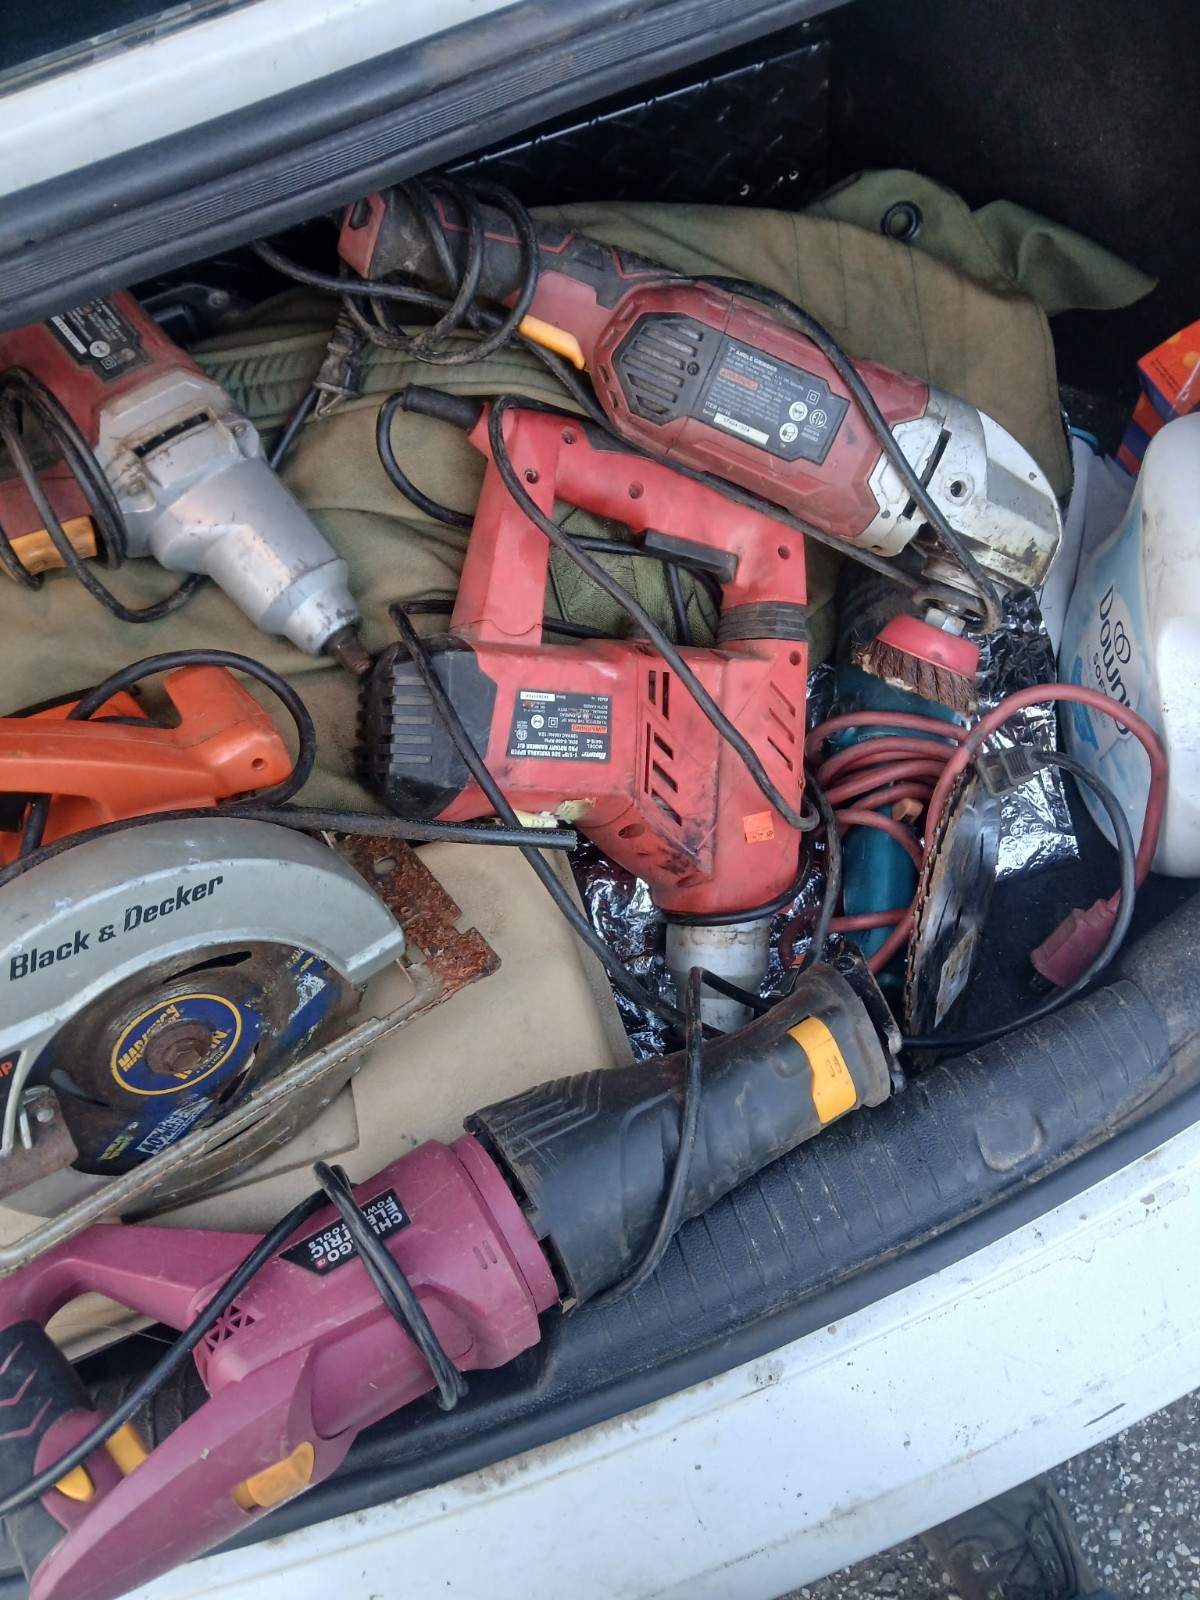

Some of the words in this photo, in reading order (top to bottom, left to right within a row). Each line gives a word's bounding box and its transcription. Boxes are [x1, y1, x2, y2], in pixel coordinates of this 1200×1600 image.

[735, 350, 754, 362] ANGLE
[753, 358, 778, 372] GRINDER
[1099, 585, 1133, 734] Downy
[10, 930, 90, 981] Black
[98, 924, 116, 943] &
[124, 875, 224, 932] Decker
[117, 1004, 181, 1072] MARON
[309, 1201, 399, 1260] ELETRIC
[362, 1196, 393, 1217] POW
[307, 1223, 346, 1249] TOOLS
[325, 1210, 404, 1263] CHIGO
